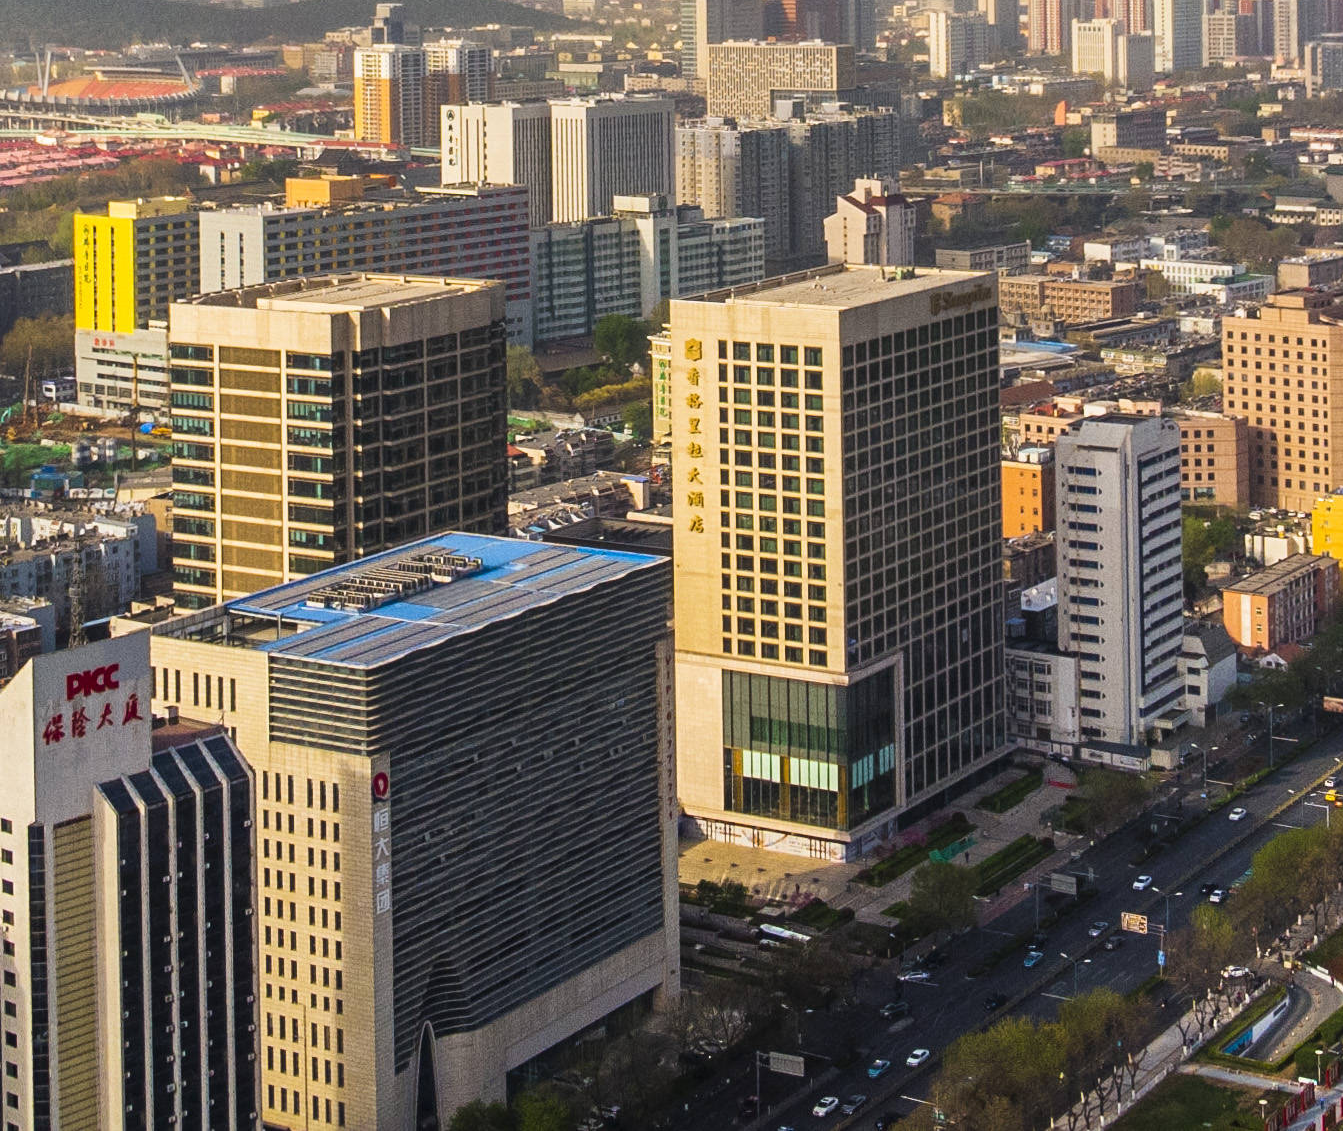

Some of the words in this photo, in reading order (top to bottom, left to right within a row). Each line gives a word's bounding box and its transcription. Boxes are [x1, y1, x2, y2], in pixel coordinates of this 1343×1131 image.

[686, 367, 704, 534] 香格里拉大酒店
[43, 693, 143, 746] 保险大厦
[66, 663, 120, 702] PICC
[374, 808, 390, 914] 恒大集团
